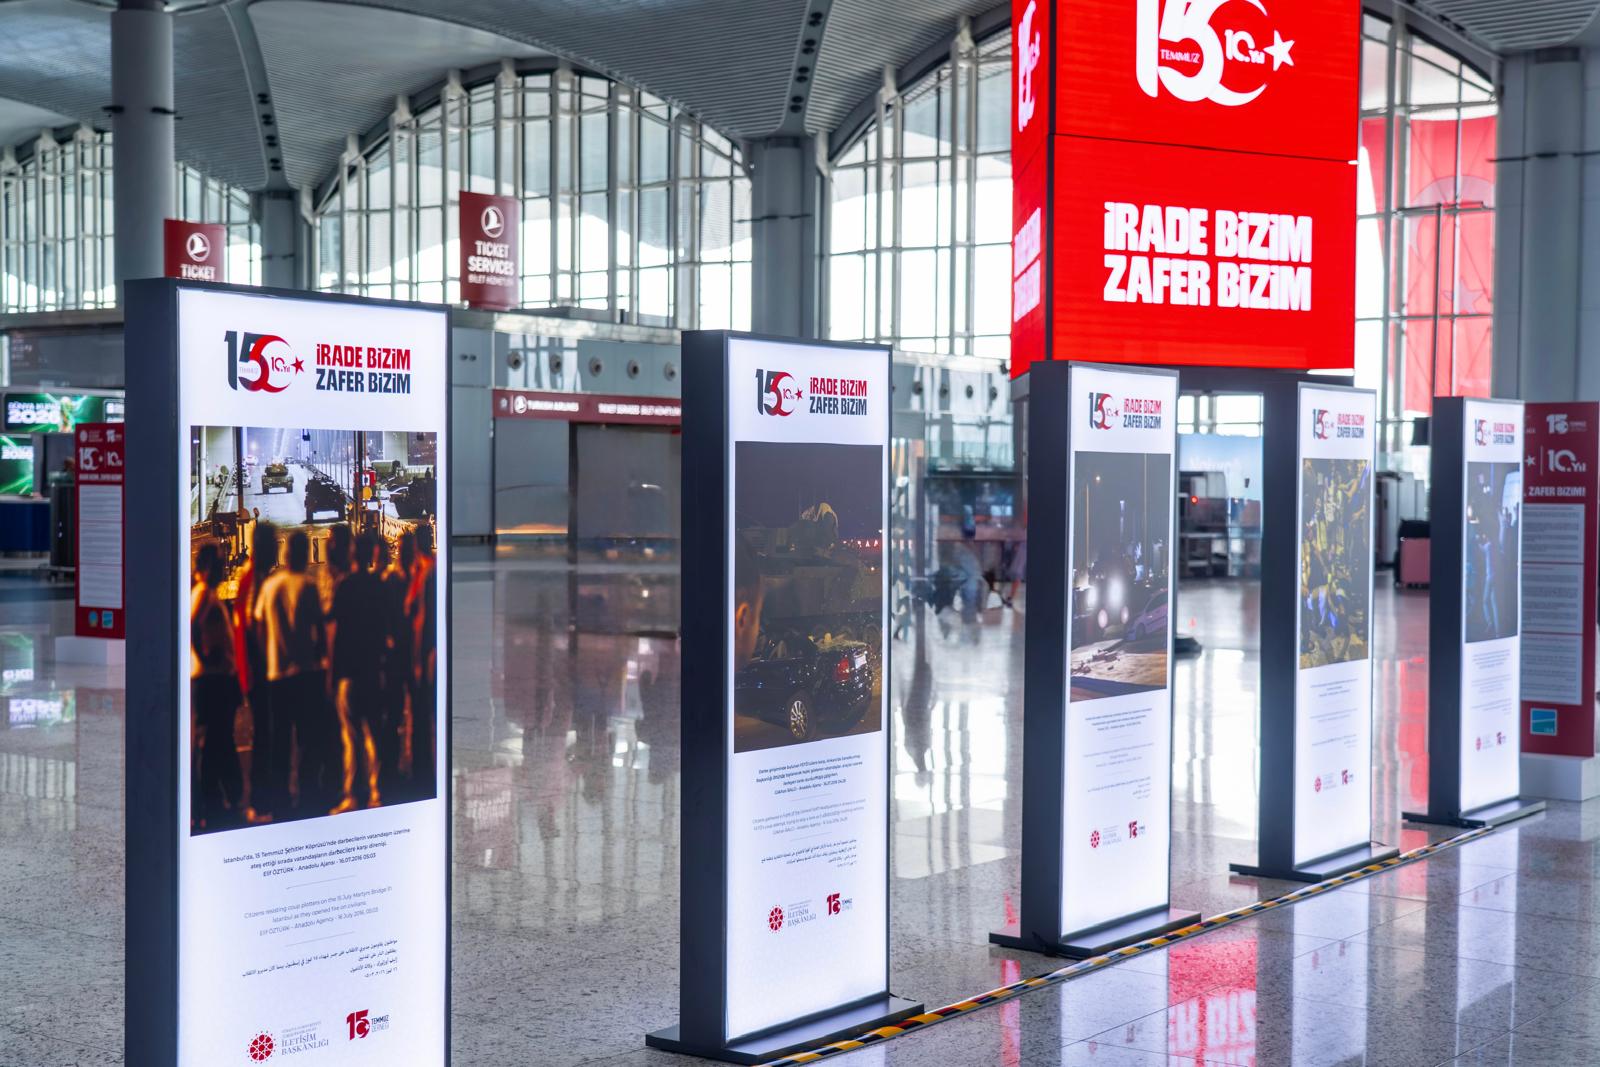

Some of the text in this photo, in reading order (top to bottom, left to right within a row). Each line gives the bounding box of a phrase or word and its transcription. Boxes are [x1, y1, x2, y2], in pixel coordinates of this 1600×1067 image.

[1136, 0, 1223, 102] 15
[1160, 49, 1200, 64] TEMMUZ
[475, 240, 509, 258] TICKET
[181, 264, 216, 280] TICKET
[468, 256, 514, 276] SERVICES
[1104, 254, 1210, 306] ZAFER
[224, 330, 270, 392] 15
[316, 368, 364, 392] ZAFER
[755, 368, 782, 416] 15
[810, 396, 838, 414] ZAFER
[8, 410, 61, 424] 2026
[1124, 414, 1142, 428] ZAFER
[1546, 414, 1568, 434] 15
[1528, 486, 1556, 496] ZAFER
[826, 893, 841, 916] 15
[346, 1008, 370, 1040] 15
[282, 1040, 329, 1056] BAŞKANLIĞI
